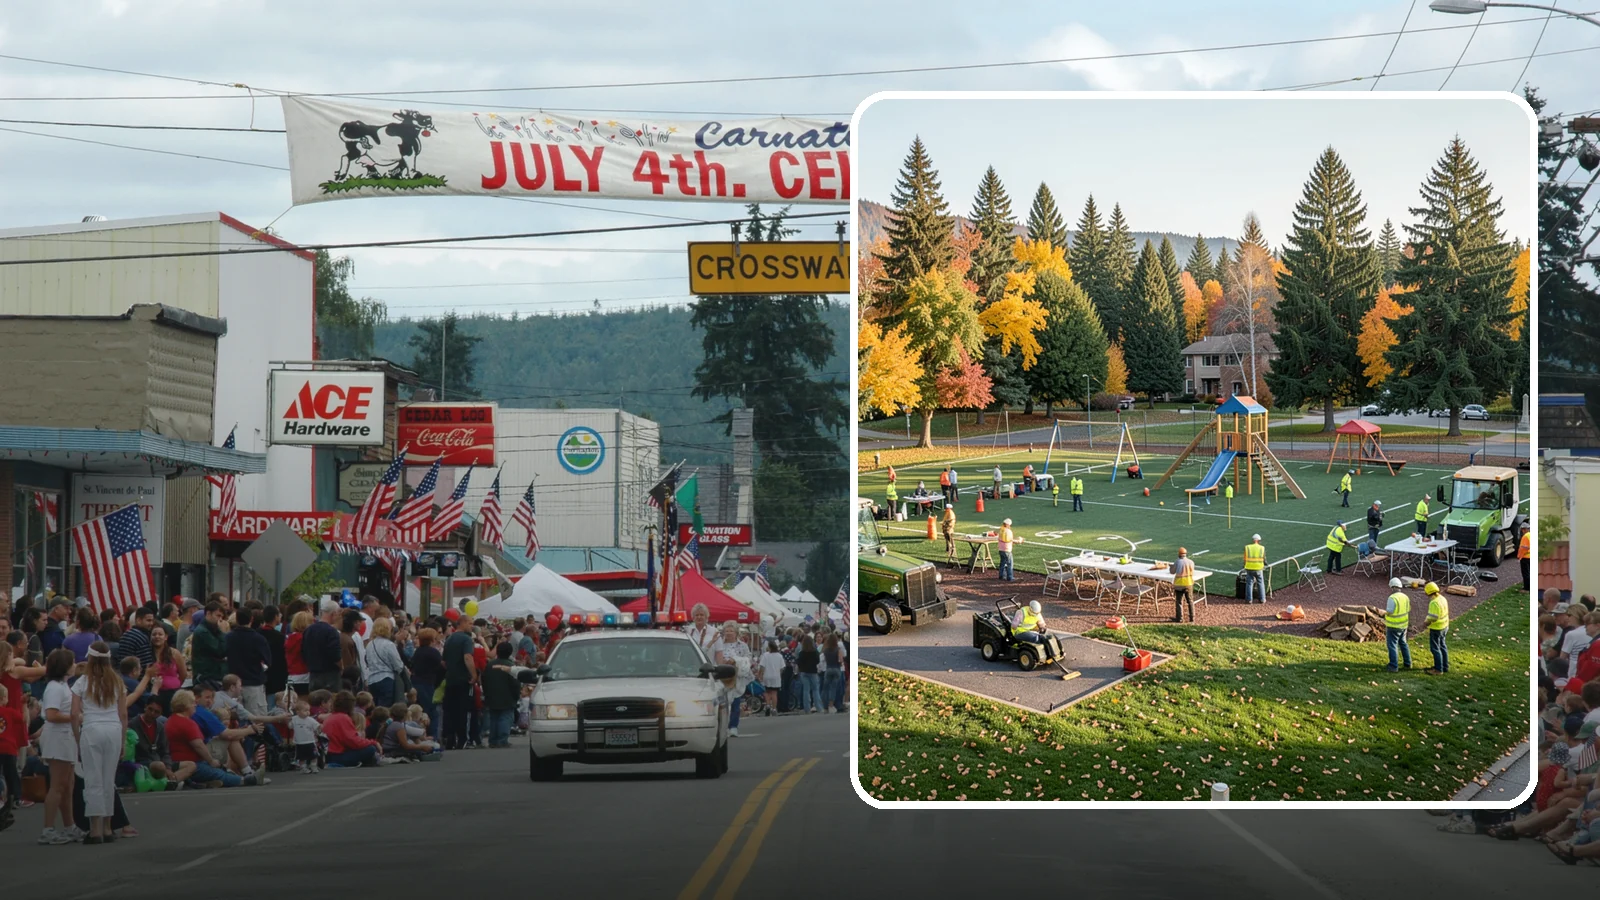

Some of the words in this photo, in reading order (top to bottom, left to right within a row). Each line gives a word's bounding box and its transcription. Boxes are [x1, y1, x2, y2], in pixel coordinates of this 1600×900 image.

[481, 141, 605, 192] JULY
[632, 150, 746, 198] 4th.
[697, 254, 850, 280] CROSSWA
[282, 380, 373, 420] ACE
[405, 409, 452, 422] CEDAR
[283, 421, 370, 436] Hardware
[416, 428, 477, 447] Coca-Cola
[353, 467, 385, 480] Simpl
[83, 485, 94, 494] St.
[95, 485, 125, 495] Vincent
[126, 486, 136, 495] de
[138, 486, 155, 495] Paul
[688, 526, 742, 535] CRNATION
[699, 535, 730, 543] GLASS
